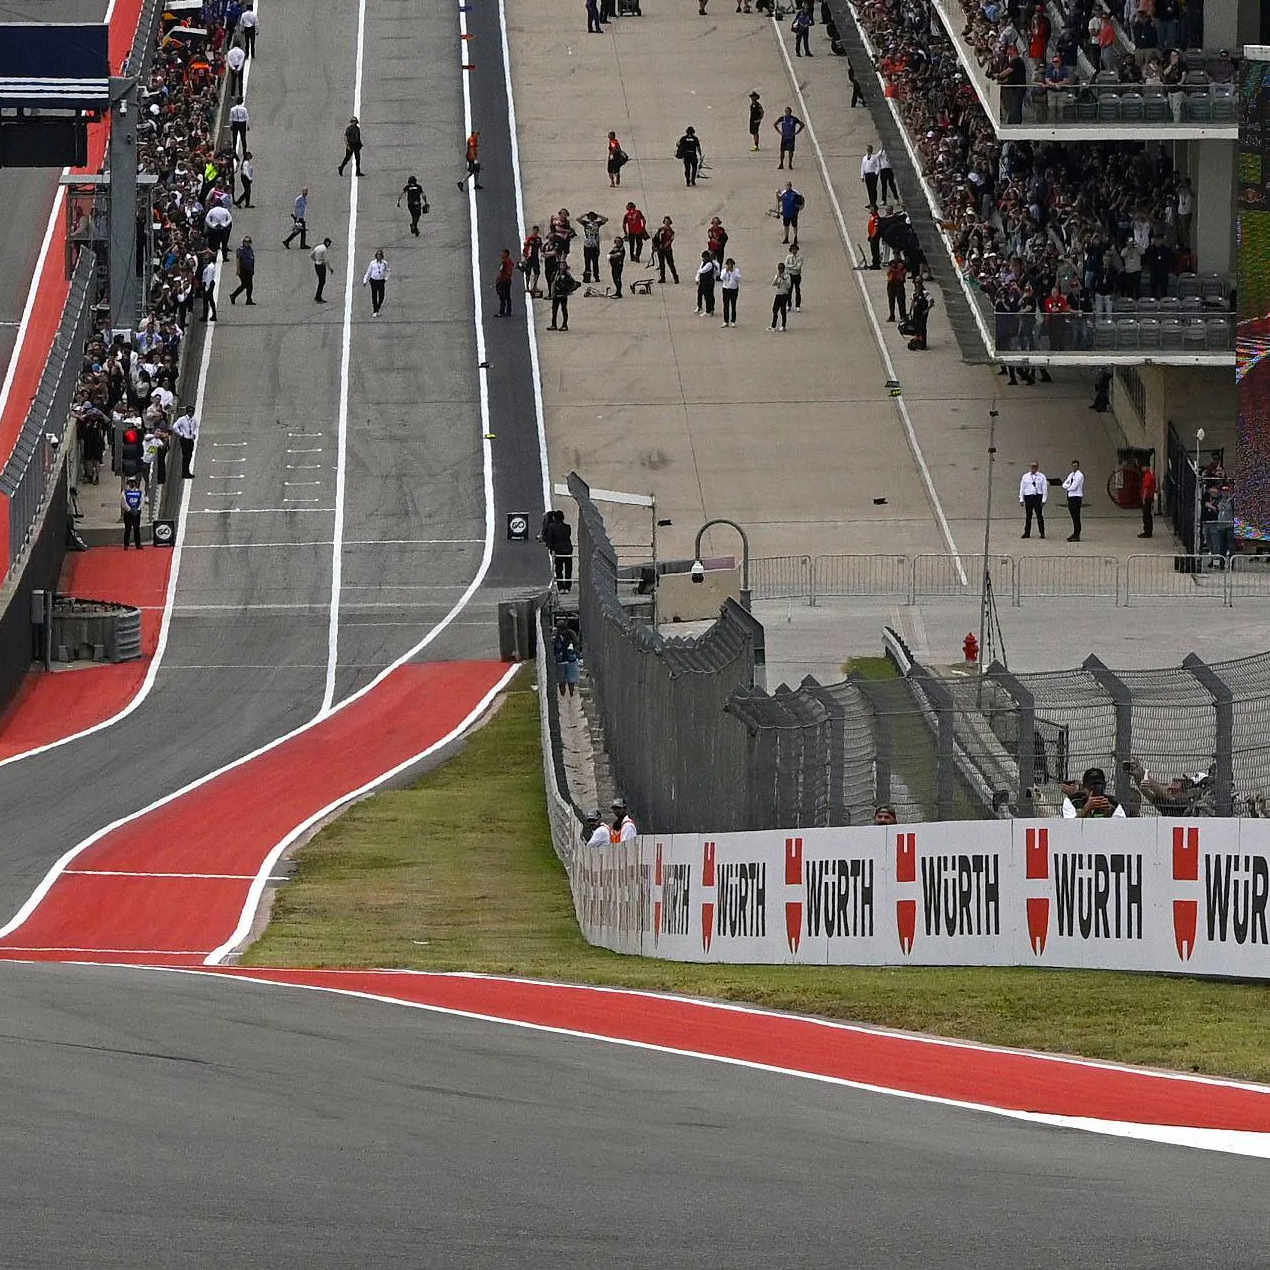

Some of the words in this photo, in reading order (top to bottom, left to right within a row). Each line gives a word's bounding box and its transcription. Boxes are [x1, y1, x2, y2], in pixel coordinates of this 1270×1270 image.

[717, 862, 766, 938] WÜRTH
[806, 859, 874, 939] WÜRTH
[921, 854, 1000, 937] WÜRTH
[1053, 853, 1143, 940] WÜRTH
[1204, 853, 1269, 945] WÜR
